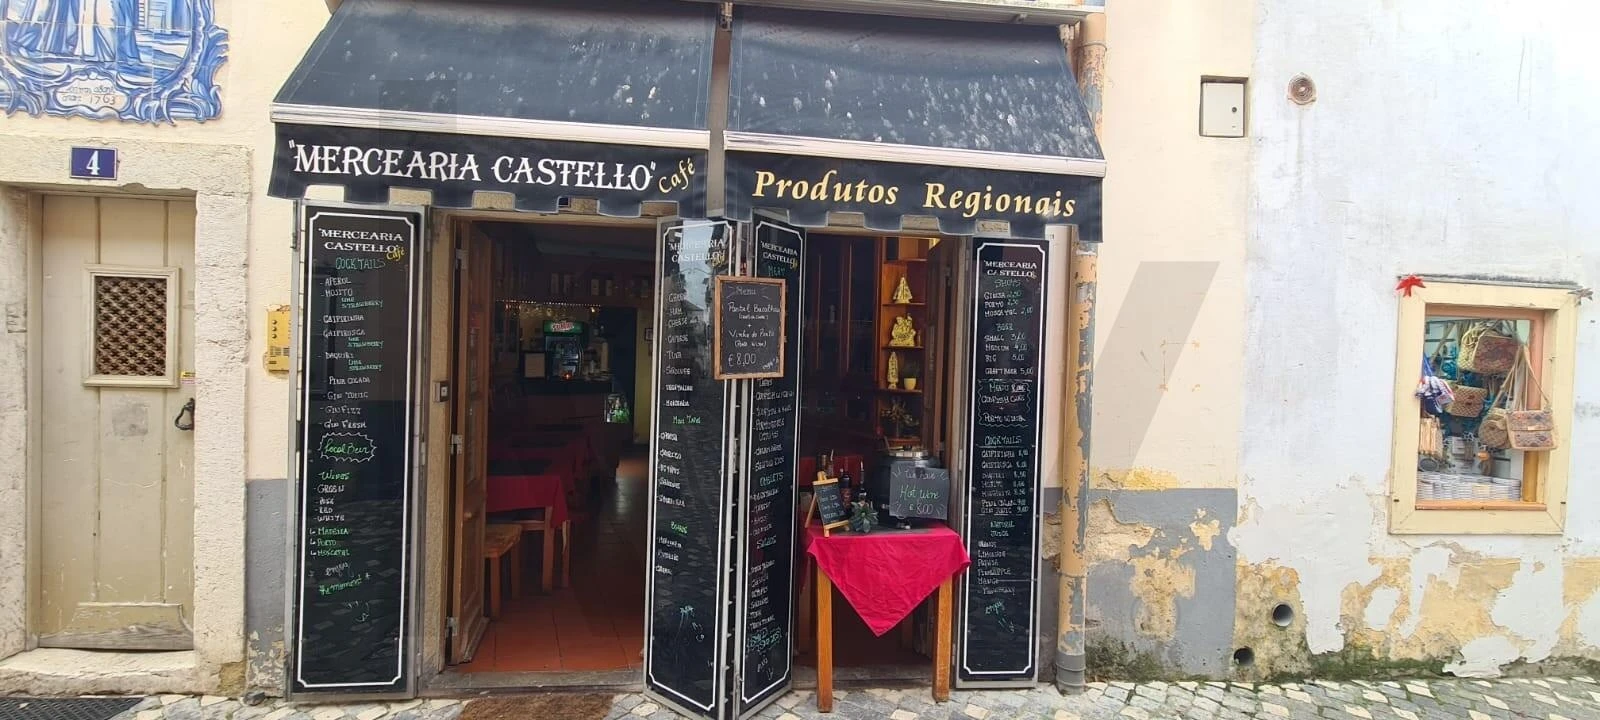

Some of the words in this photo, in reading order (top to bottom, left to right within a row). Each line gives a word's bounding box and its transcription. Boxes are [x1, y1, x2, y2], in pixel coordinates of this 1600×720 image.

[87, 150, 100, 175] 4
[659, 157, 697, 193] Café
[752, 170, 899, 205] Produtos
[922, 182, 1076, 217] Regionais
[325, 288, 353, 297] MOJITO
[900, 484, 916, 499] Hot
